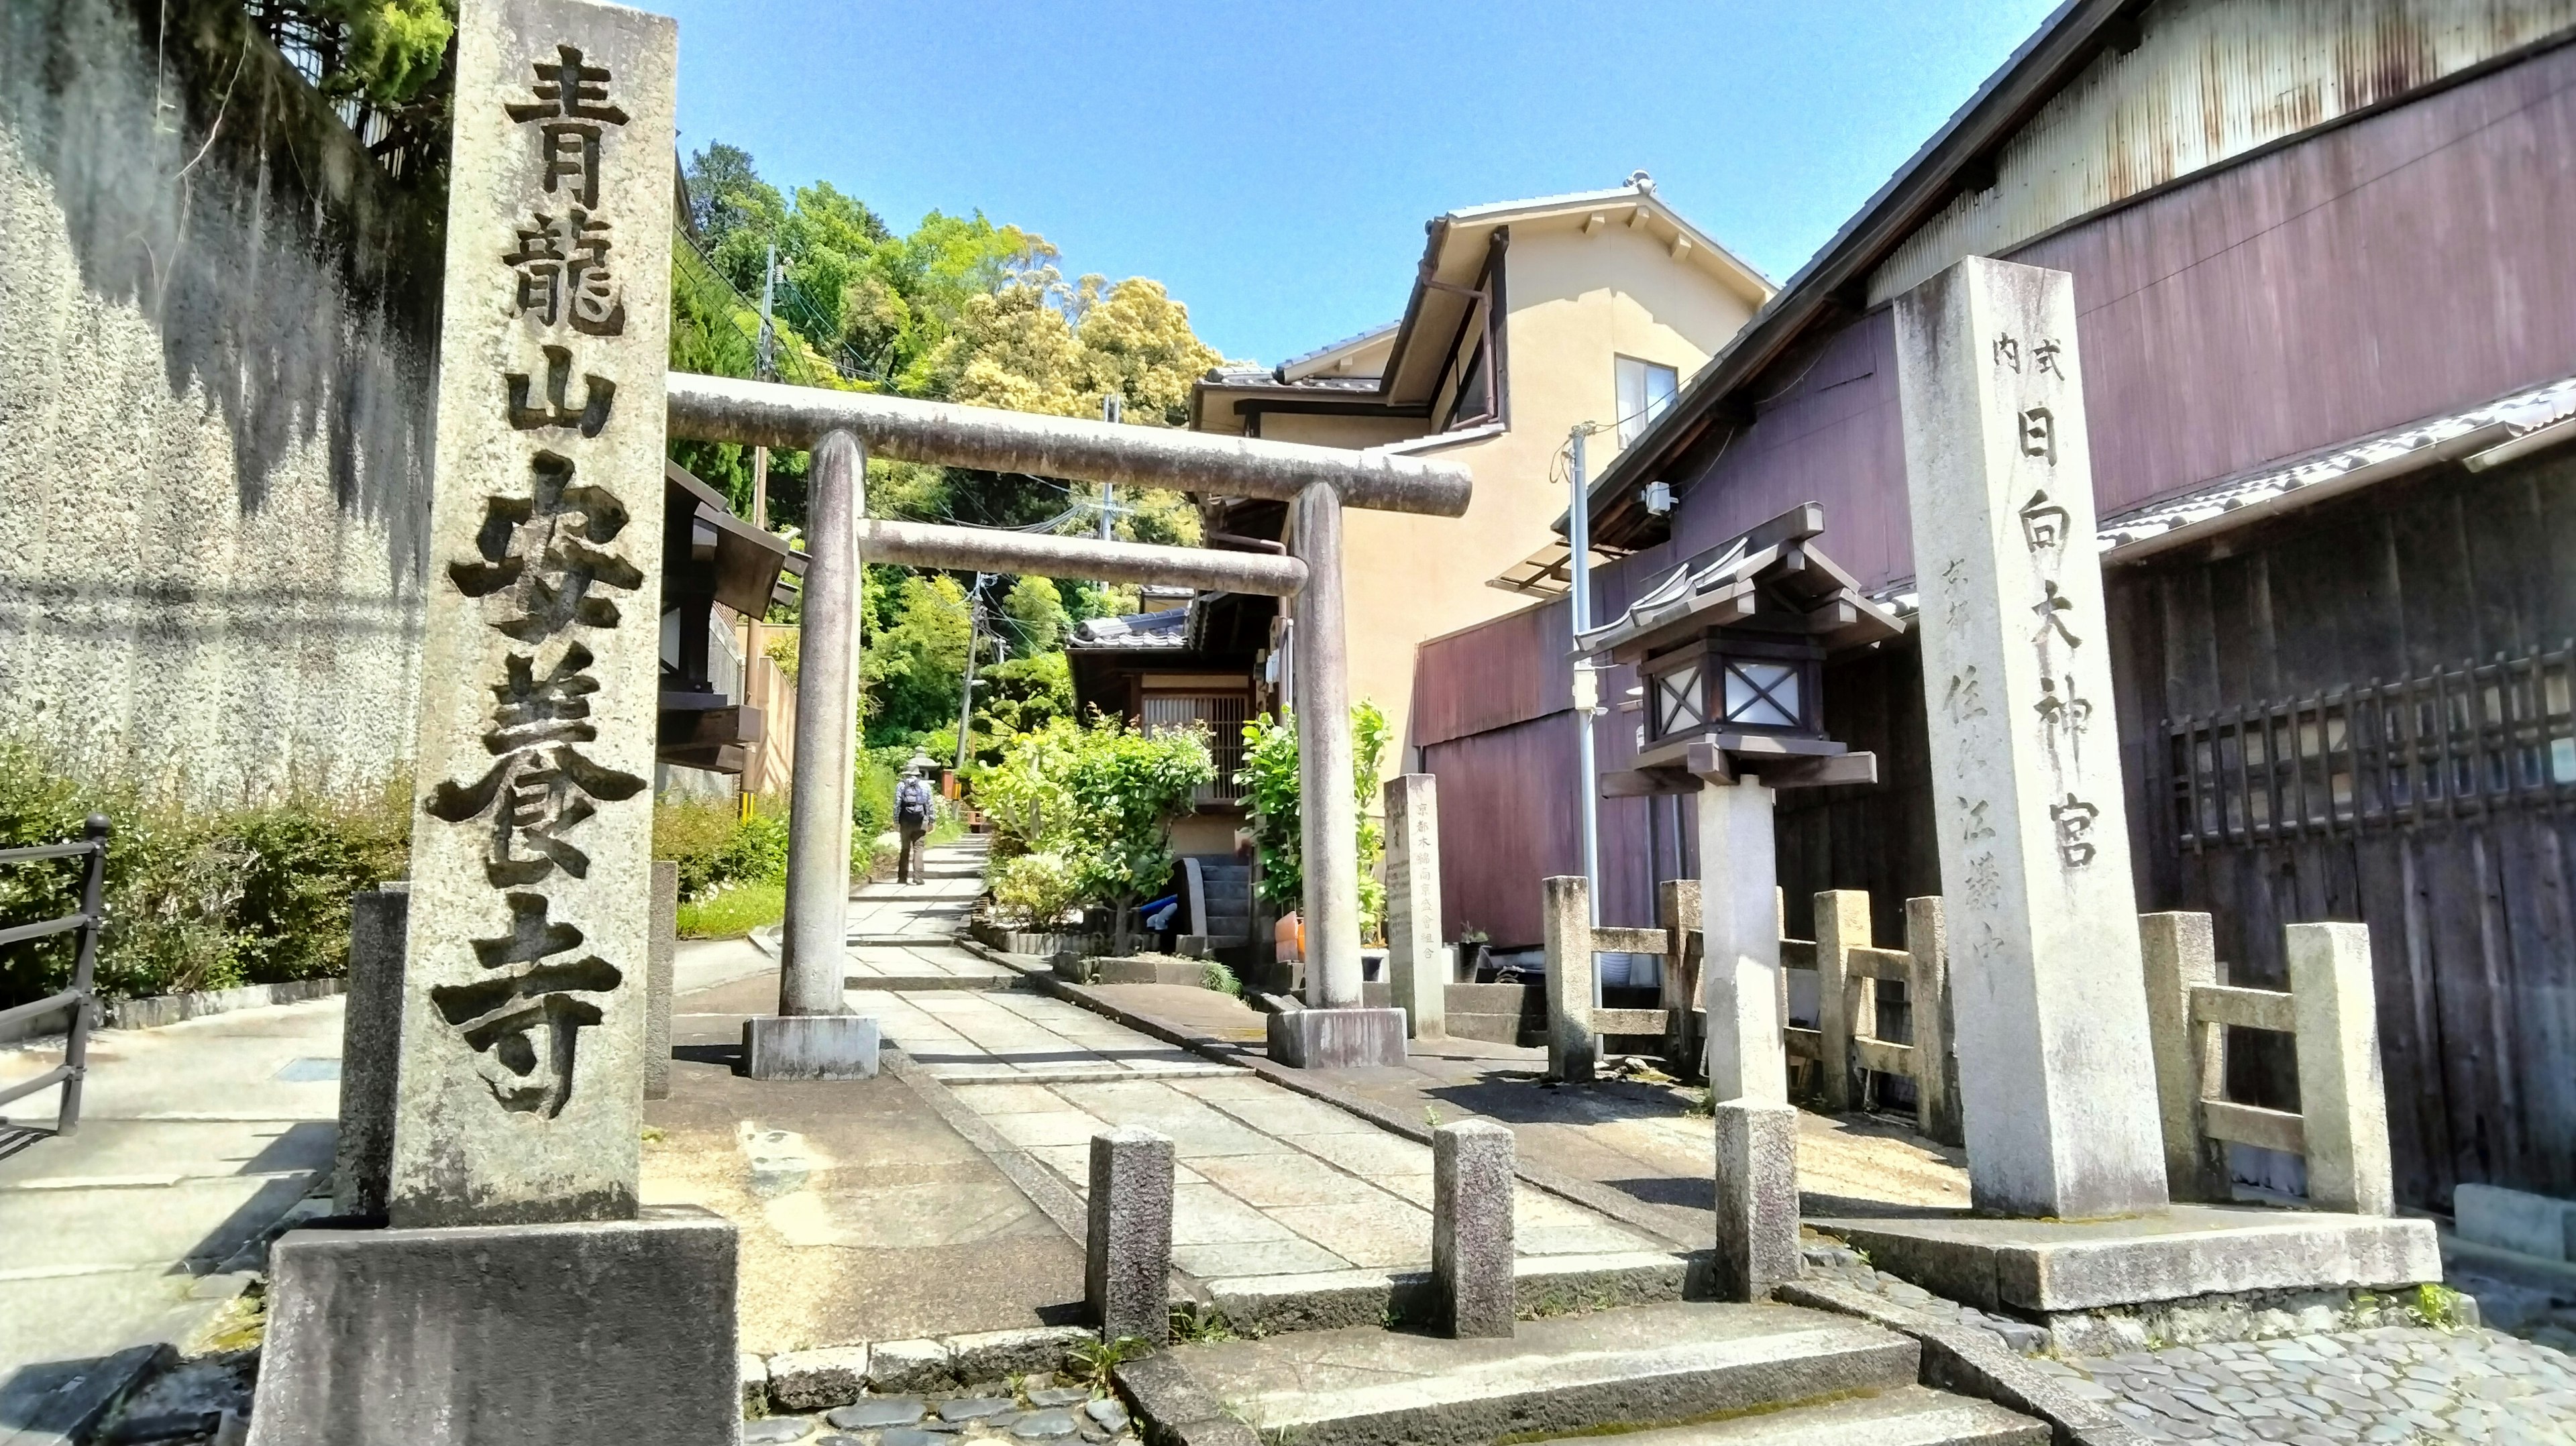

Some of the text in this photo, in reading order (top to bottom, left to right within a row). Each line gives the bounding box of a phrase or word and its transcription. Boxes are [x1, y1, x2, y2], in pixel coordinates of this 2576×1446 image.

[424, 43, 648, 1119] 青龍山安養寺
[2017, 406, 2100, 869] 日向大神宮
